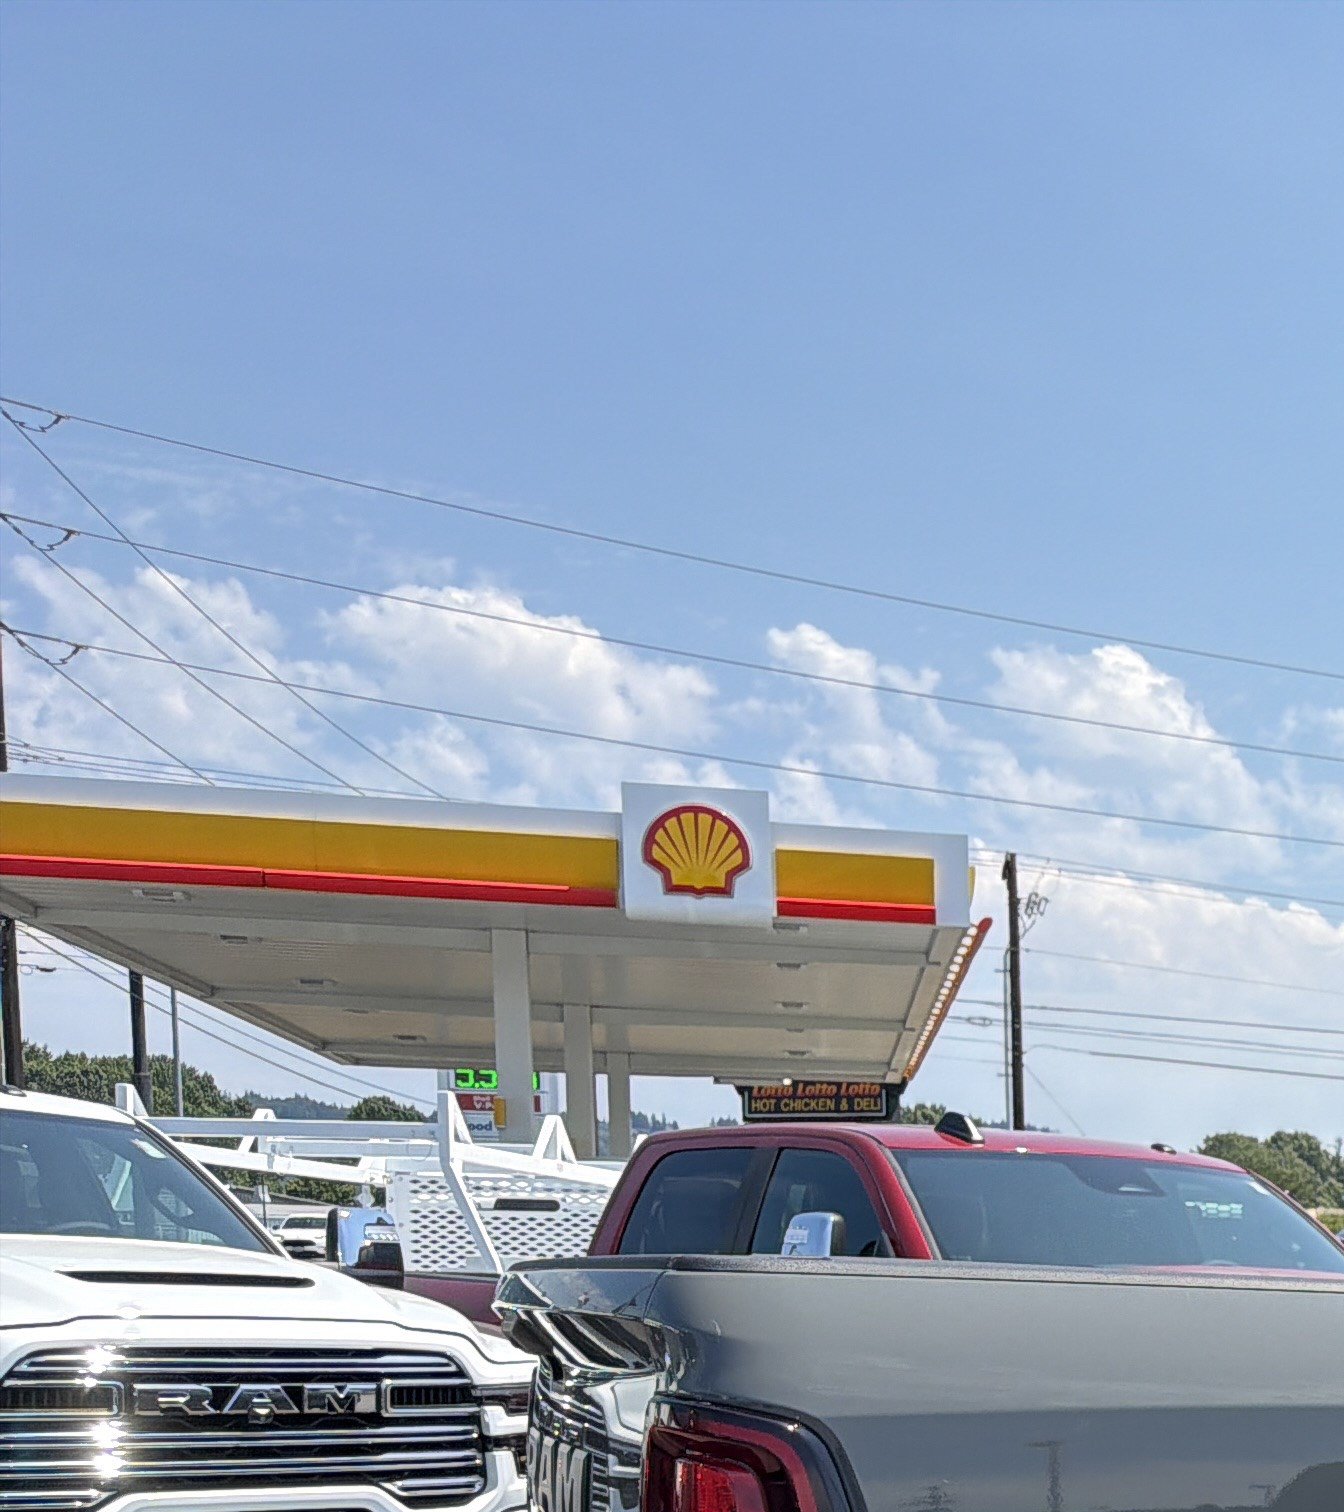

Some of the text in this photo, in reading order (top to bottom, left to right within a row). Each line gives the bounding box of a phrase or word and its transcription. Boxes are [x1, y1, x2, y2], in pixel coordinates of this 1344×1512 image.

[797, 1083, 838, 1097] Lotto
[841, 1082, 881, 1097] Lotto
[751, 1099, 880, 1112] HOT CHICKEN & DELI
[467, 1120, 493, 1131] ood
[133, 1383, 377, 1415] RAM
